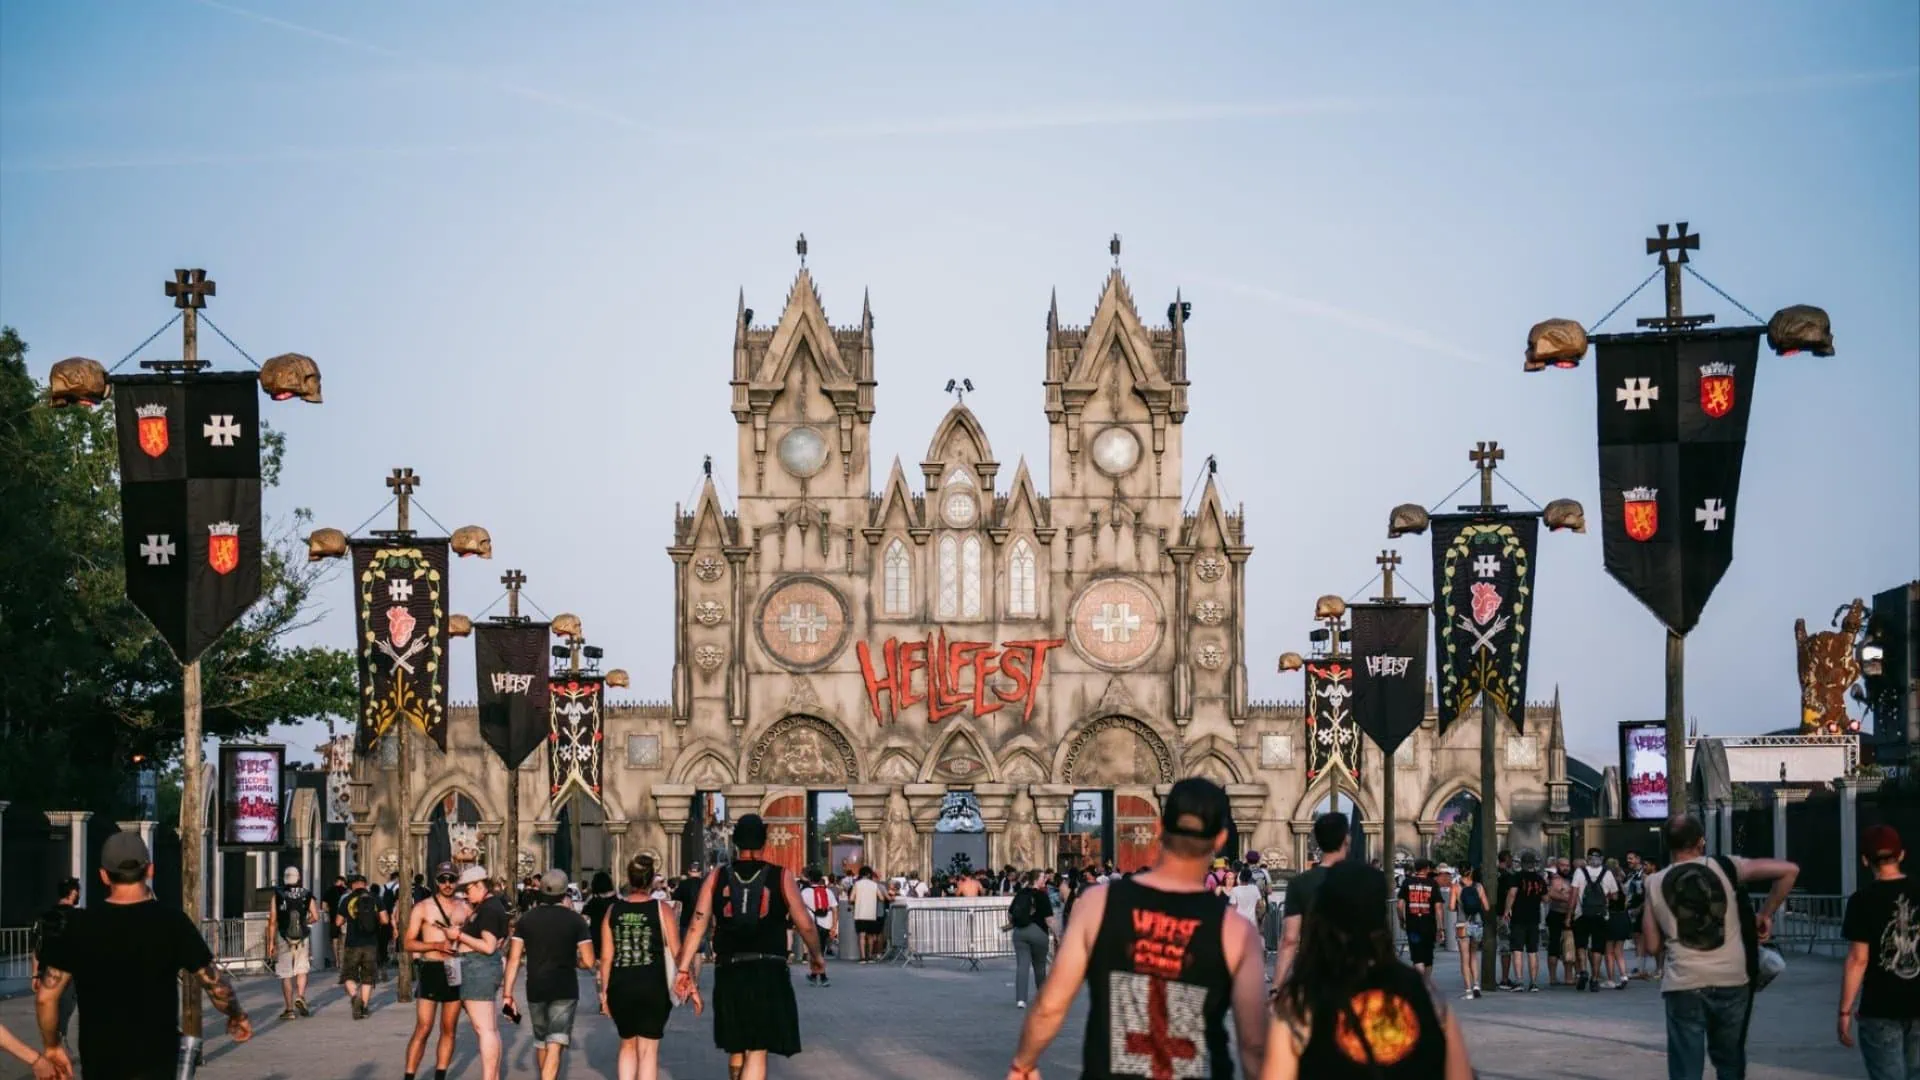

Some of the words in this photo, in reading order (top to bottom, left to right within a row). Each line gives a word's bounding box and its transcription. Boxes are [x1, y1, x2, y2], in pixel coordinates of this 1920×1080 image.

[856, 625, 1066, 727] HELLFEST
[1365, 653, 1414, 679] HELLFEST
[490, 672, 536, 696] HELLFEST
